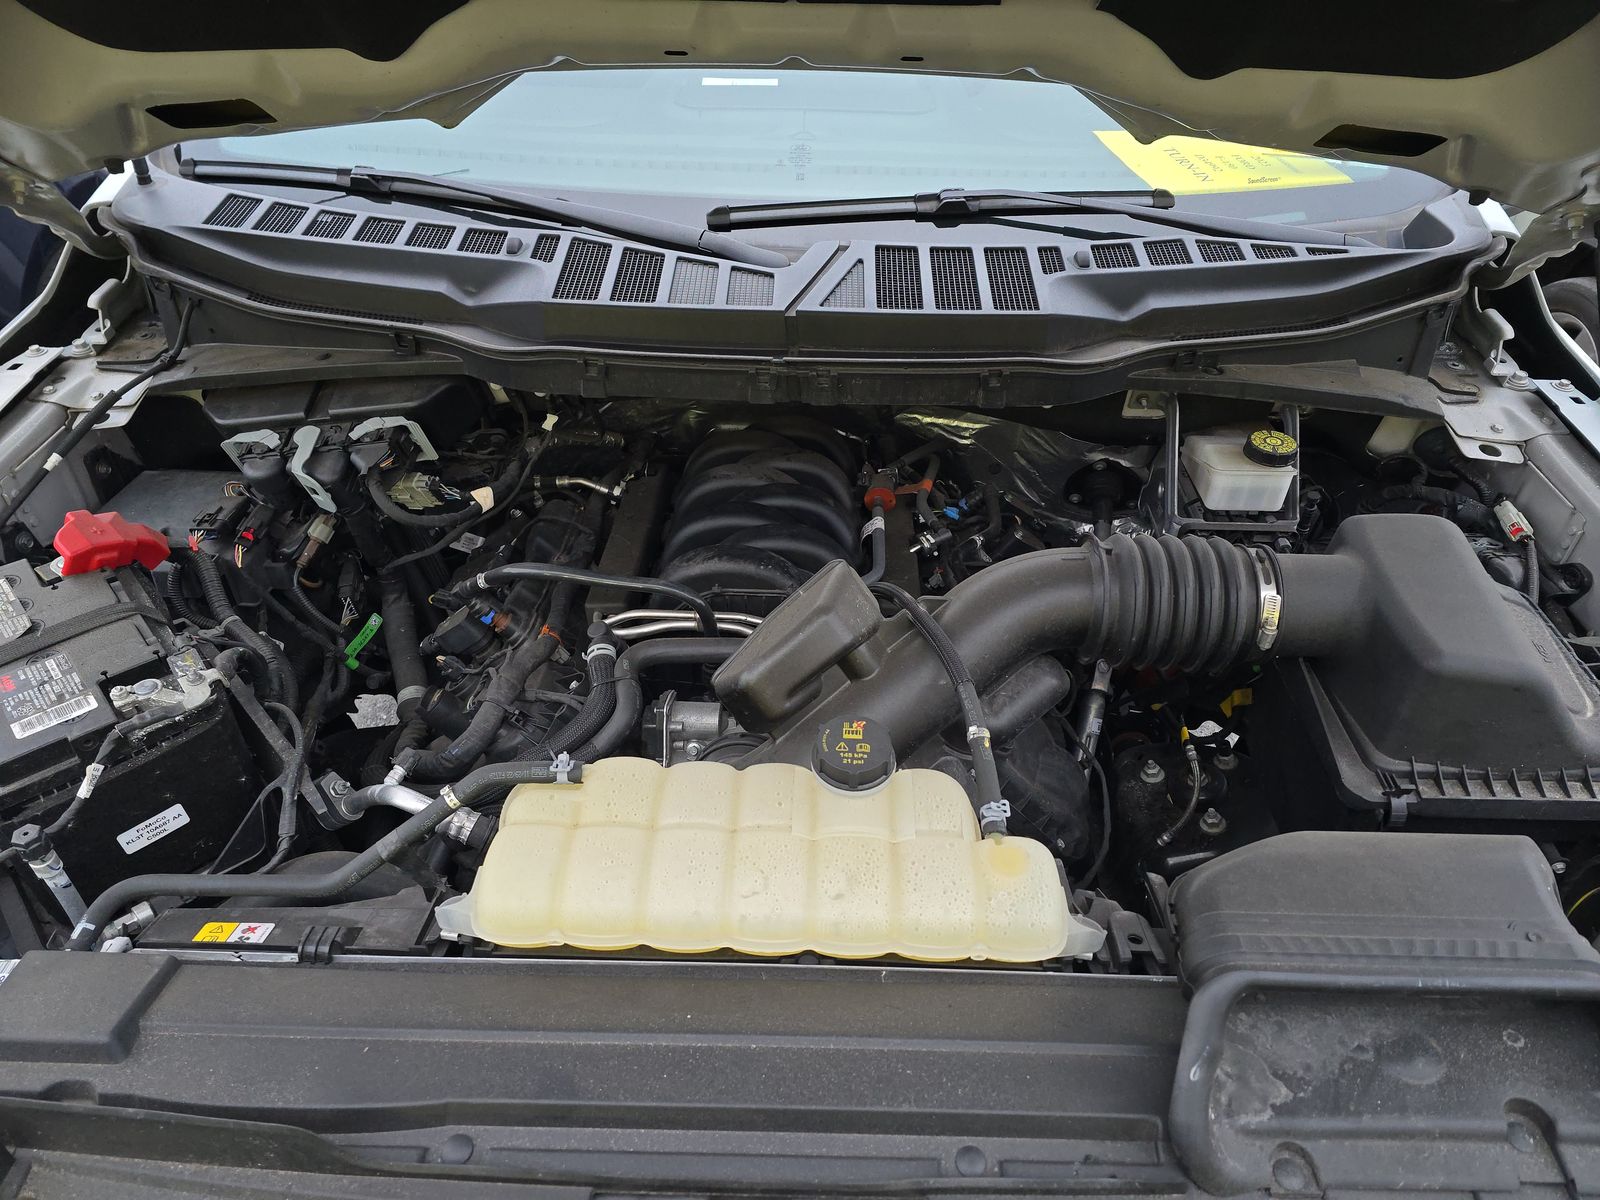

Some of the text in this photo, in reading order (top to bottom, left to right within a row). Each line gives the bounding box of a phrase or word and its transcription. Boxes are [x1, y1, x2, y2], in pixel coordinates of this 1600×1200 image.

[1163, 148, 1214, 182] TURN-IN
[126, 832, 145, 846] KL3T
[172, 813, 183, 821] AA
[136, 815, 166, 834] FoMoCo
